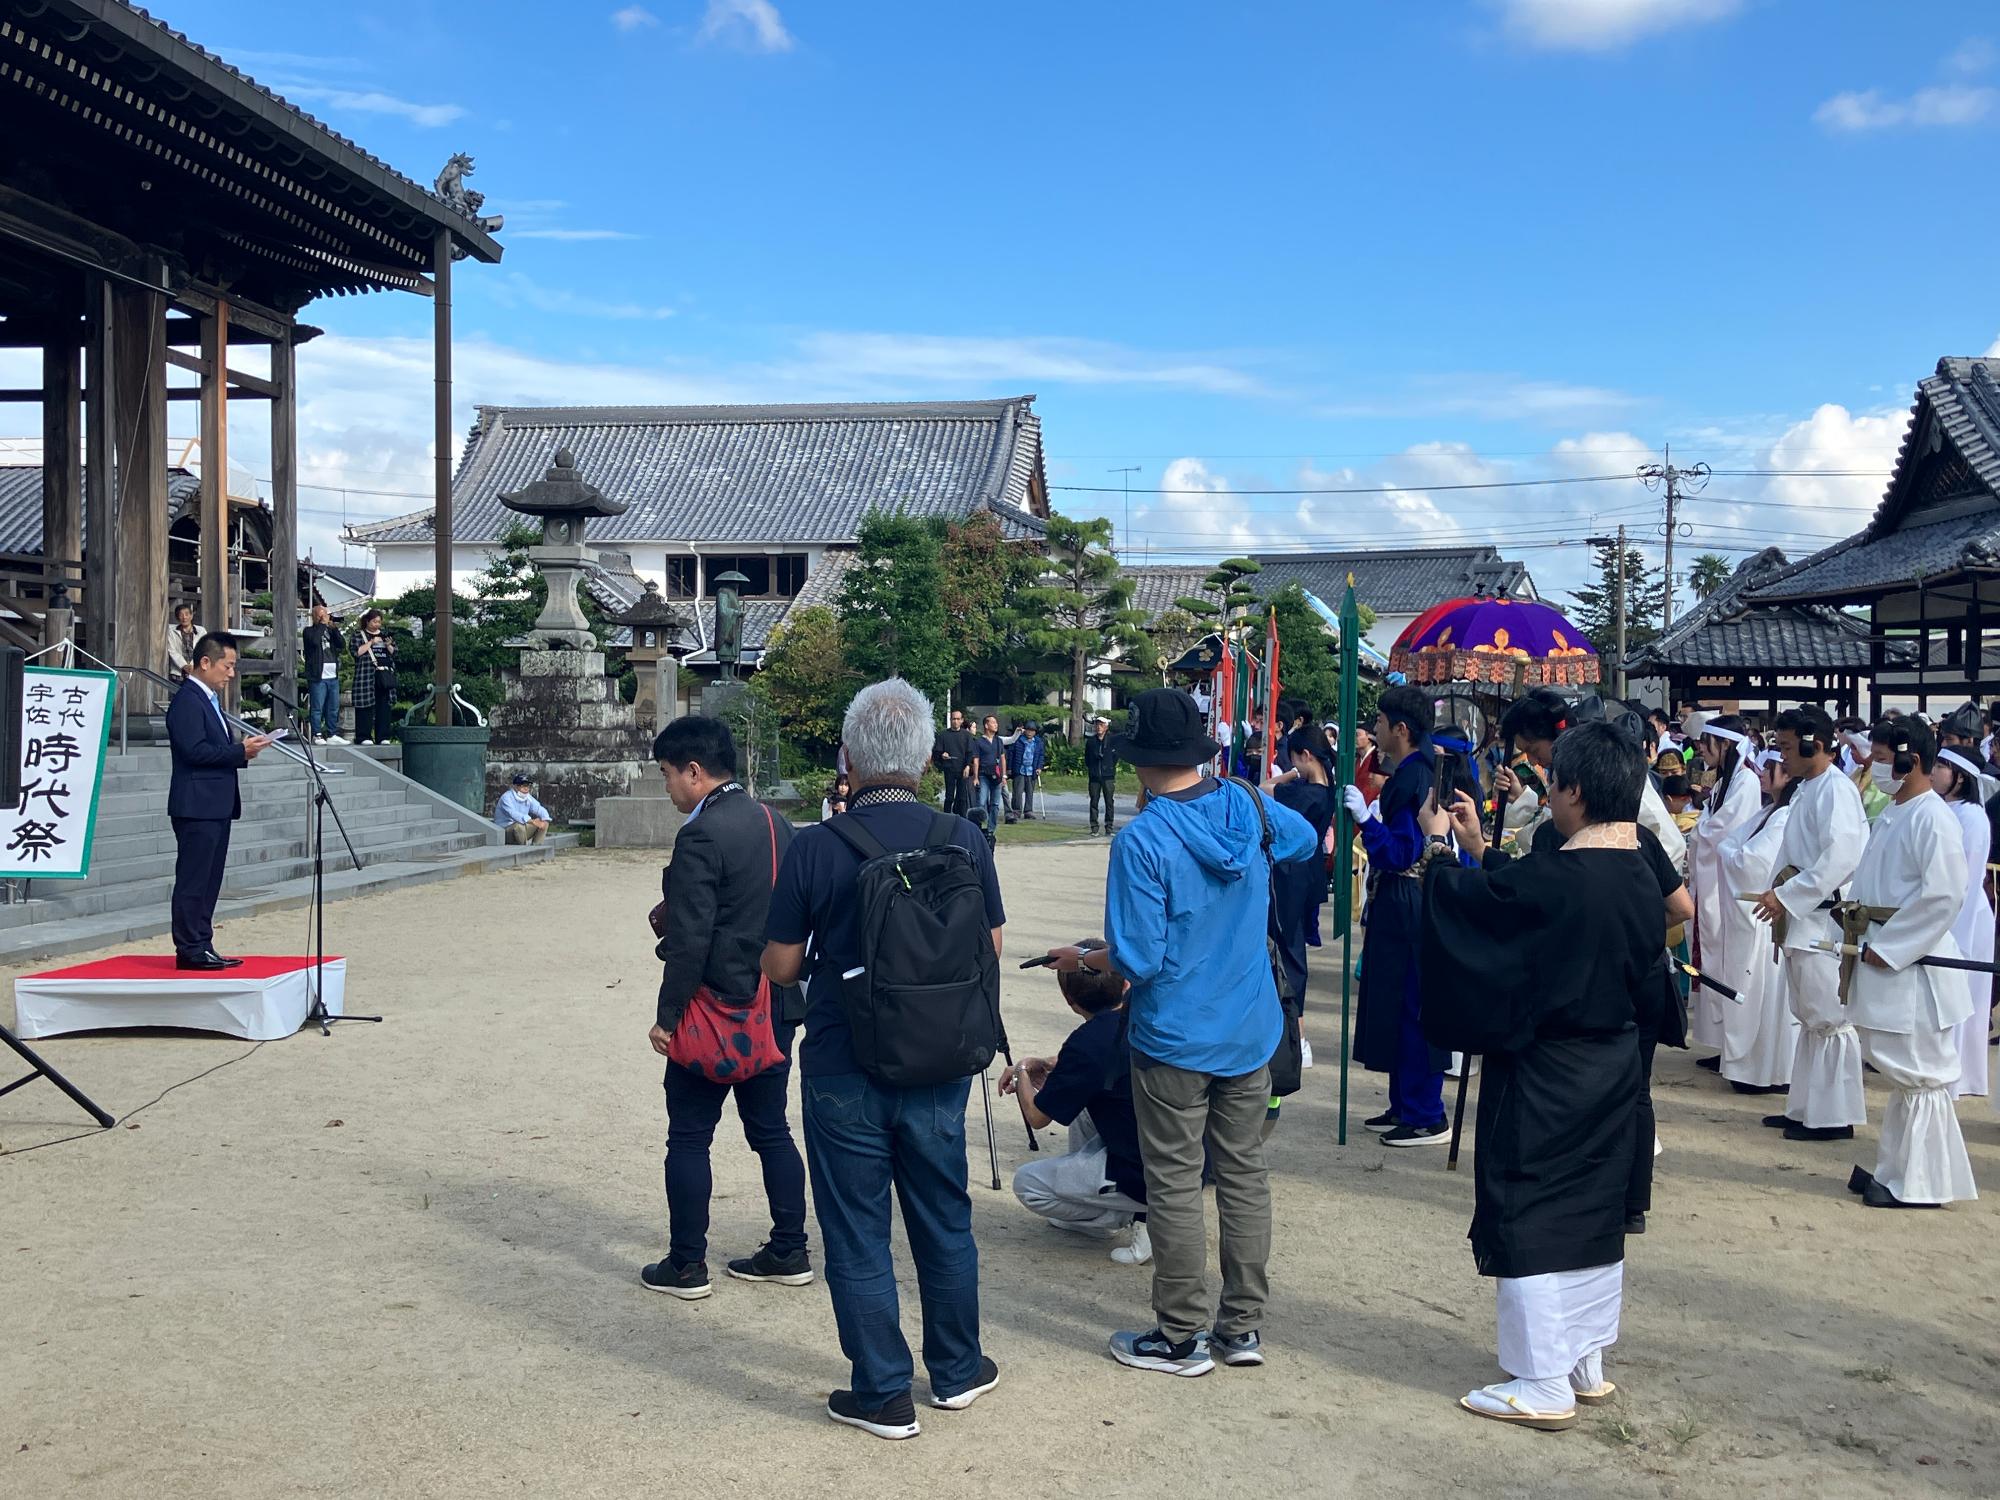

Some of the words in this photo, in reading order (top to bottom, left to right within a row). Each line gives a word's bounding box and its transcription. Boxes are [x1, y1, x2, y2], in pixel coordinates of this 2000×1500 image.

[25, 683, 55, 725] 宇佐
[58, 686, 89, 728] 古代
[6, 732, 82, 863] 時代祭
